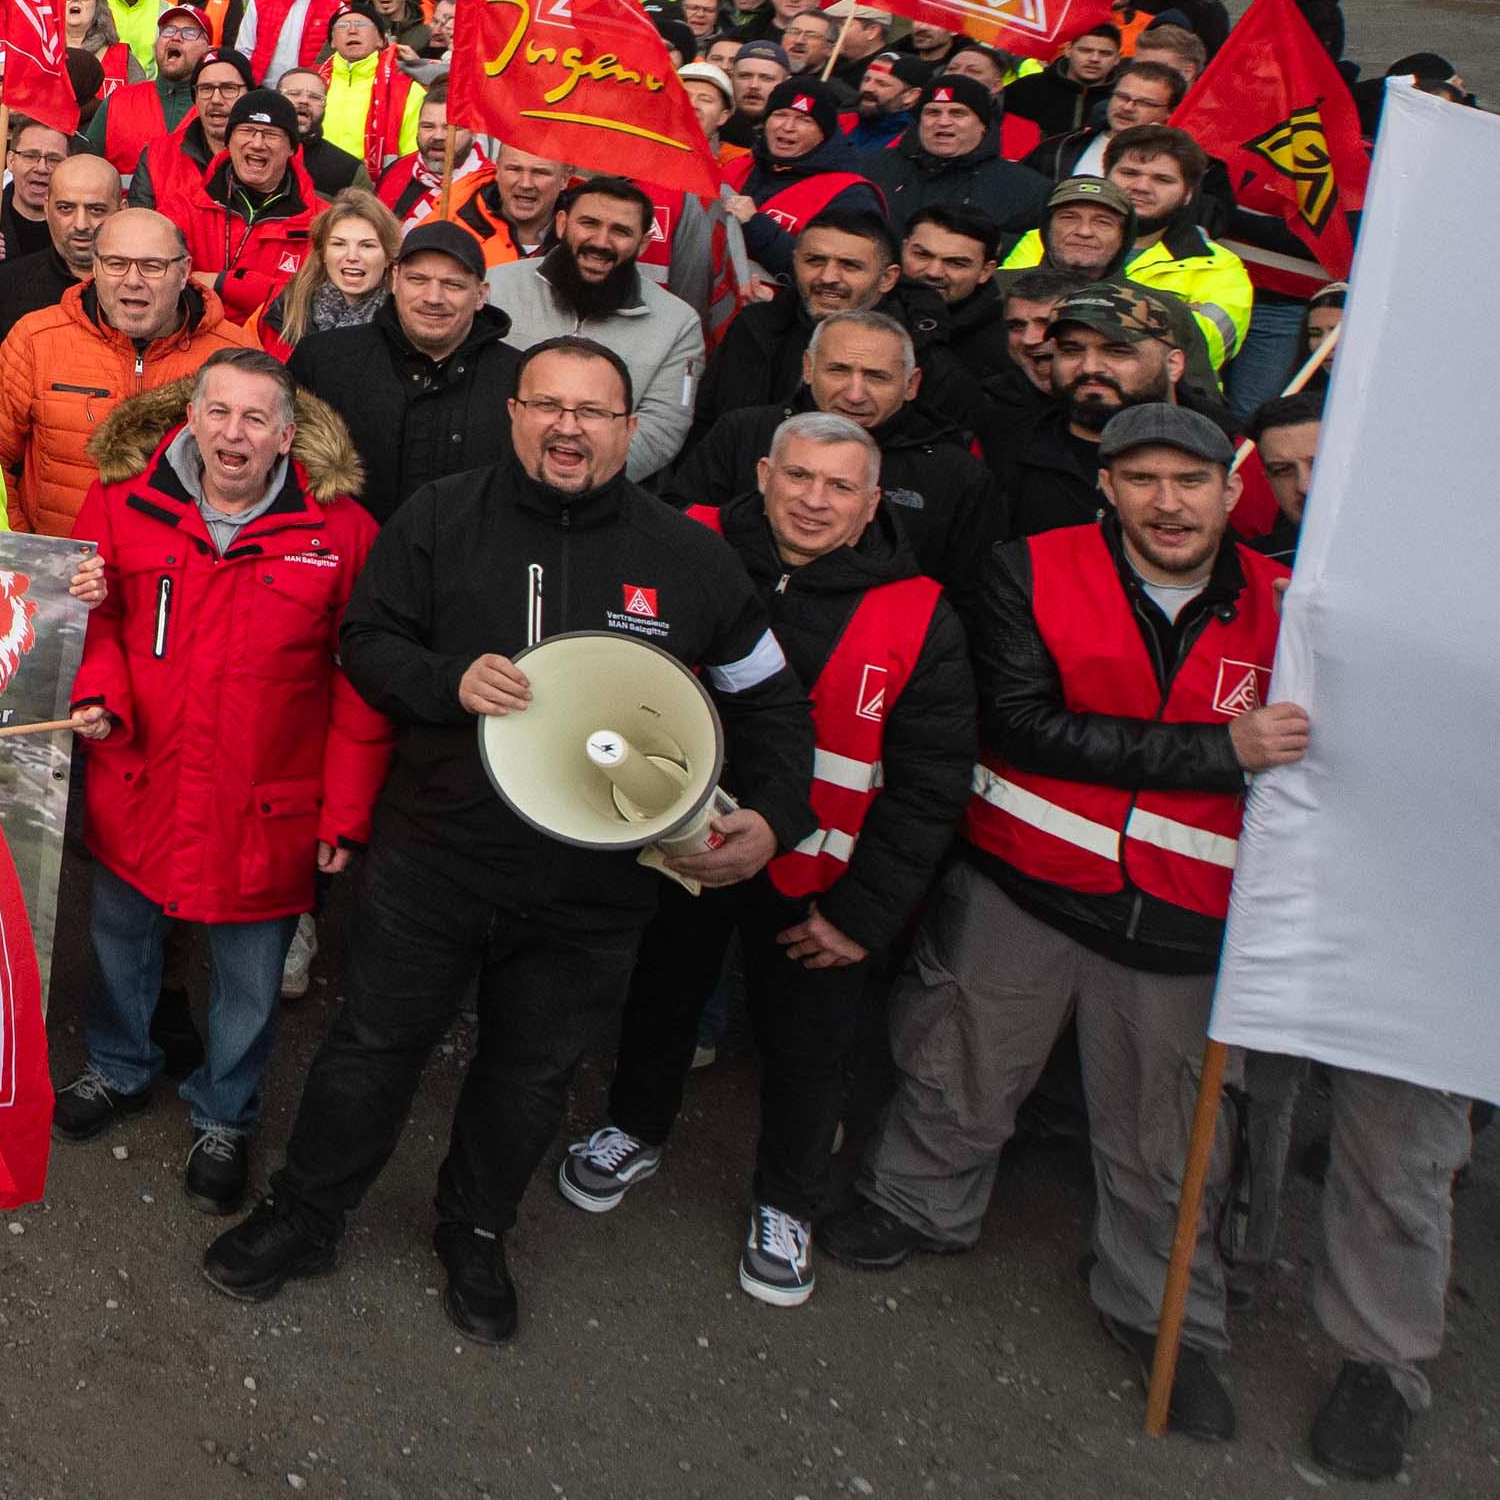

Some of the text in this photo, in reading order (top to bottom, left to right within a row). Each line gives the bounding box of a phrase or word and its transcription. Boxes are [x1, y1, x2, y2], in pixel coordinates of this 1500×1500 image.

[284, 555, 301, 563] MAN
[608, 620, 668, 636] MAN Salzgitter
